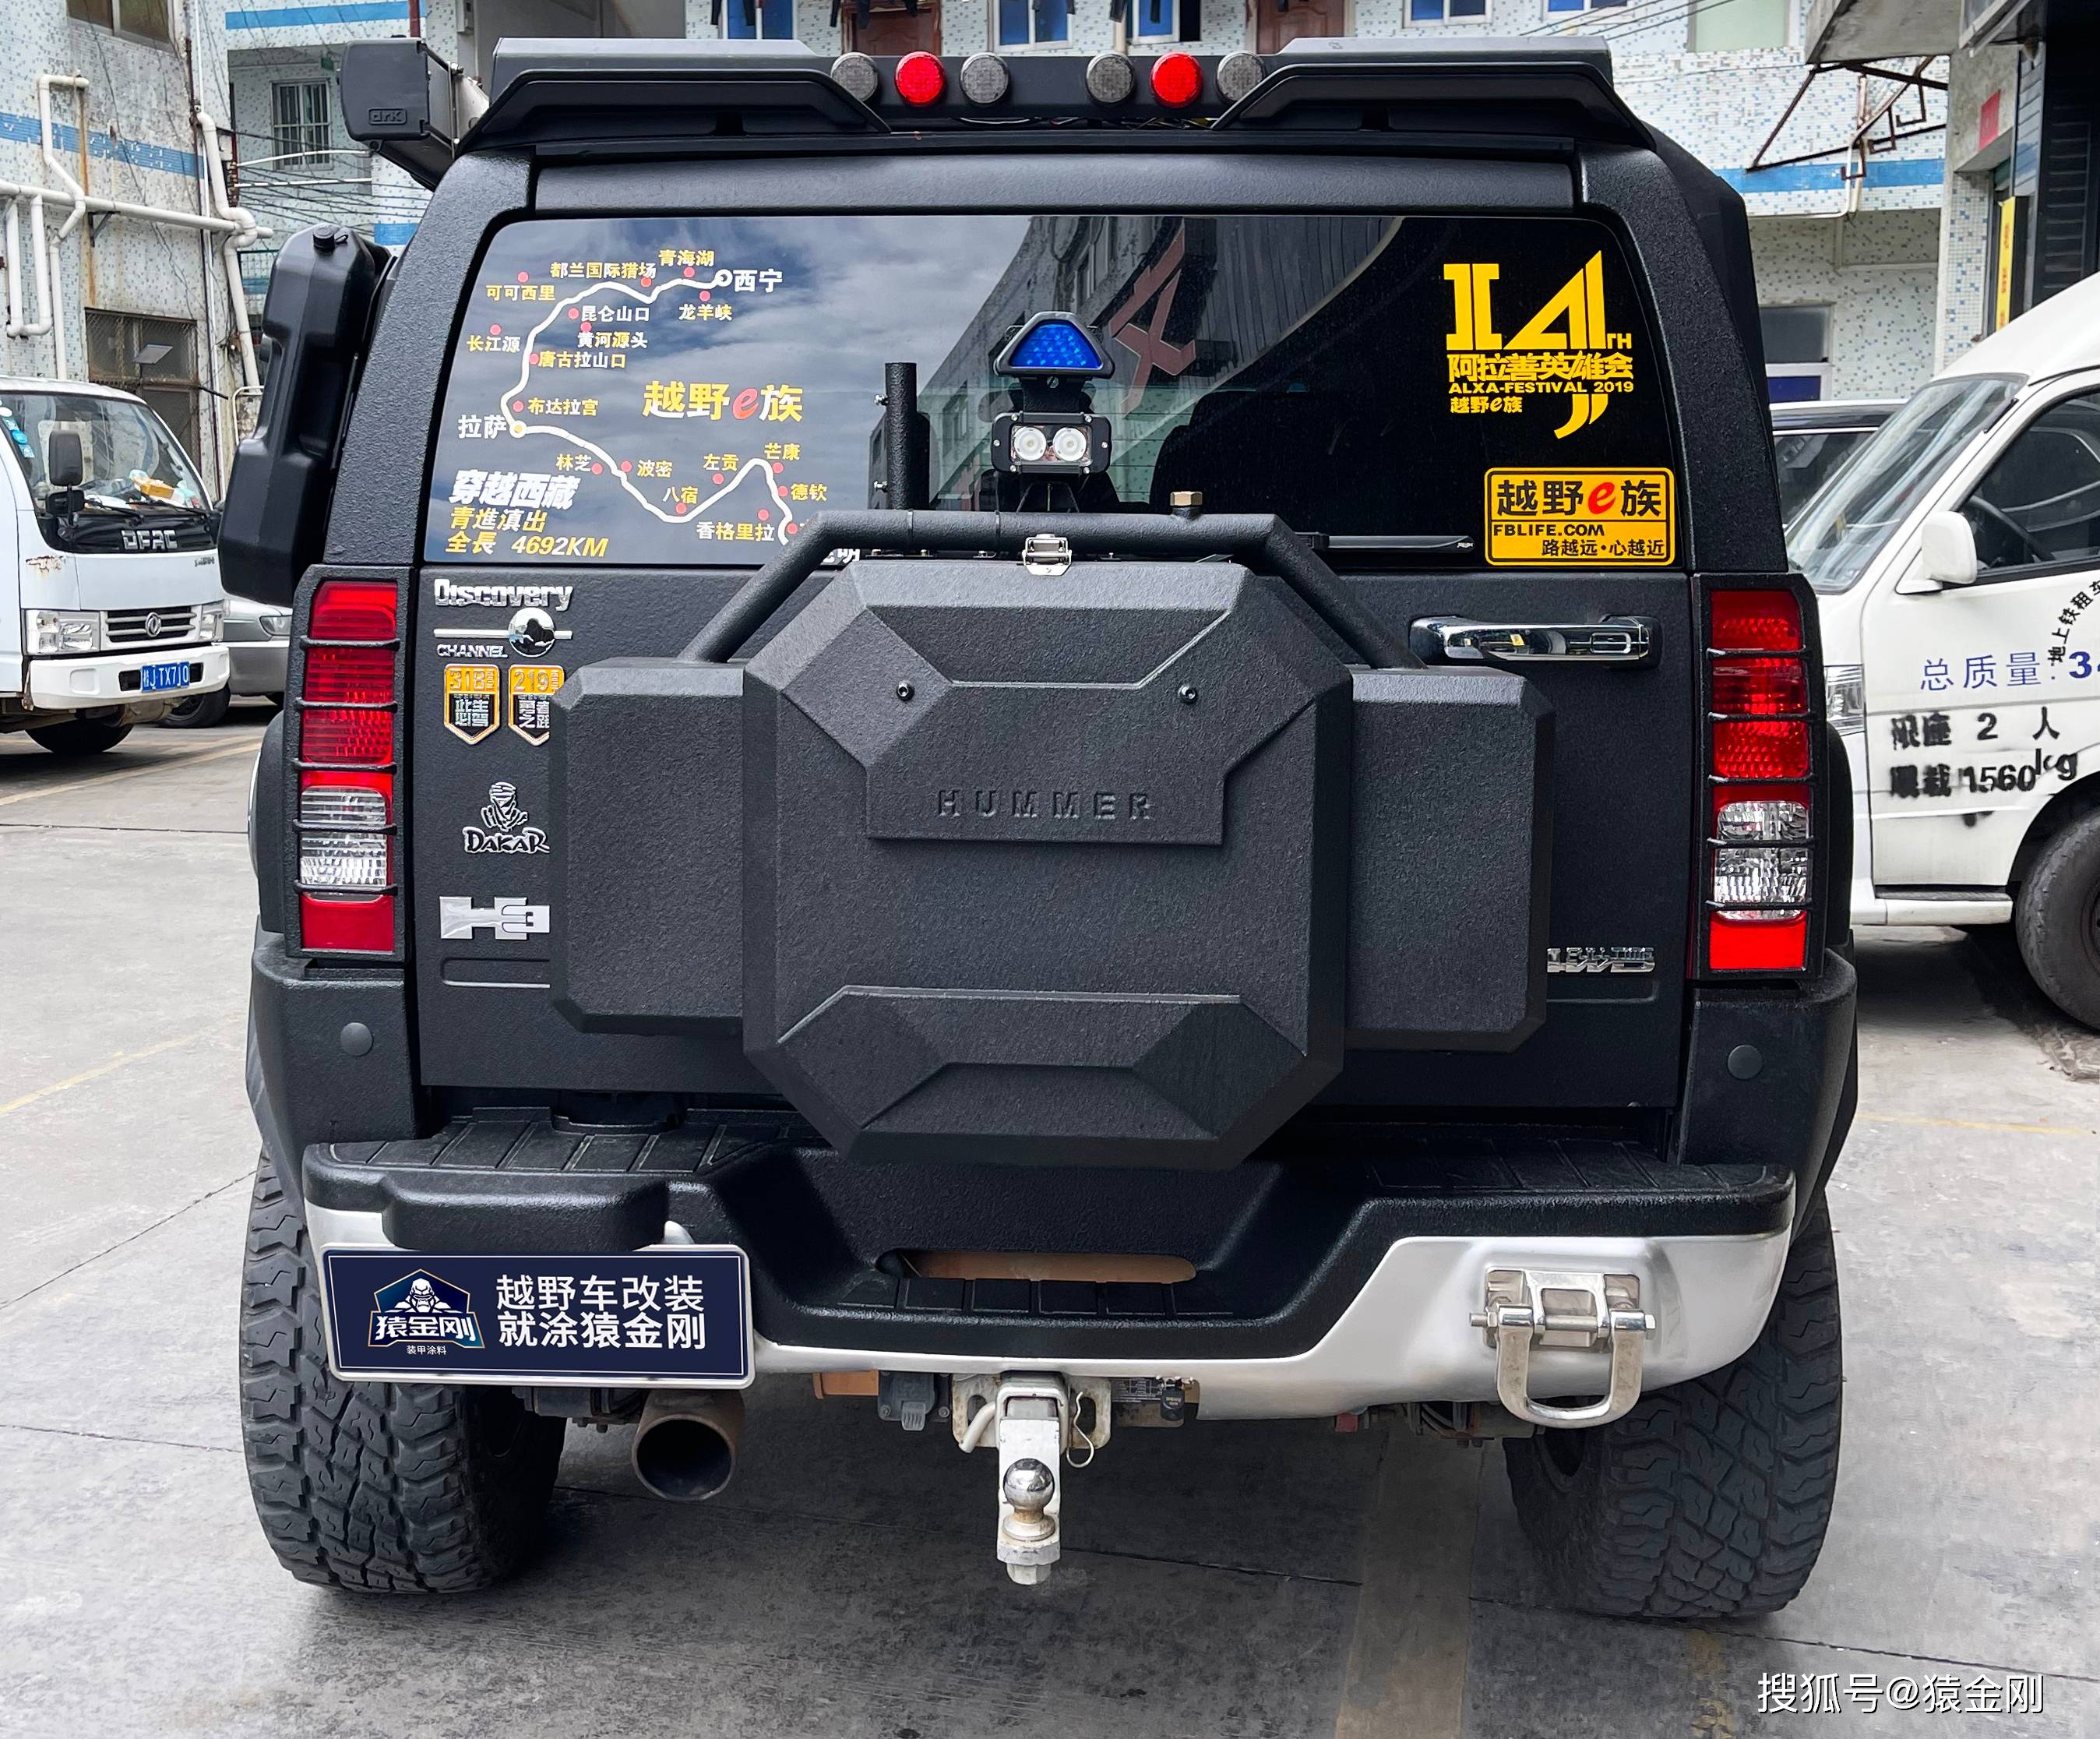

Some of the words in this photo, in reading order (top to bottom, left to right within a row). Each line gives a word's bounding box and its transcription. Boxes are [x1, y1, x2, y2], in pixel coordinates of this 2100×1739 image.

[658, 249, 716, 267] 青海湖
[550, 261, 657, 280] 都兰国际猎场
[733, 268, 784, 293] 西宁
[485, 284, 556, 302] 可可西里
[580, 305, 651, 323] 昆仑山口
[678, 304, 733, 322] 龙羊峡
[467, 335, 521, 354] 长江源
[576, 331, 649, 350] 黄河源头
[537, 351, 627, 369] 唐古拉山口
[1446, 350, 1634, 383] 阿拉善英雄会
[1448, 381, 1587, 394] ALXA-FESTIVAL
[1594, 380, 1634, 393] 2019
[527, 397, 600, 416] 布达拉宫
[642, 380, 804, 422] 越野e族
[1450, 396, 1523, 414] 越野e族
[457, 414, 508, 439] 拉萨
[764, 443, 801, 461] 芒康
[555, 453, 592, 471] 林芝
[636, 460, 673, 478] 波密
[703, 453, 739, 471] 左贡
[449, 469, 582, 510] 穿越西藏
[662, 485, 699, 504] 八宿
[791, 483, 828, 502] 德钦
[1496, 479, 1662, 517] 越野e族
[122, 530, 178, 550] DFAC
[696, 522, 776, 541] 香格里拉
[1493, 524, 1605, 537] FBLIFE.COM
[446, 531, 498, 555] 全長
[511, 535, 609, 557] 4692KM
[1542, 539, 1665, 558] 路越远·心越近
[434, 579, 573, 612] Discovery
[437, 644, 508, 658] CHANNEL
[450, 669, 486, 691] 318
[513, 670, 549, 693] 219
[1976, 712, 1999, 740] 2
[2032, 706, 2060, 739] 人
[937, 789, 1151, 820] HUMMER
[495, 1273, 705, 1313] 越野车改装
[375, 1315, 475, 1342] 猿金刚
[497, 1310, 706, 1350] 就涂猿金刚
[407, 1345, 447, 1356] 装甲涂料
